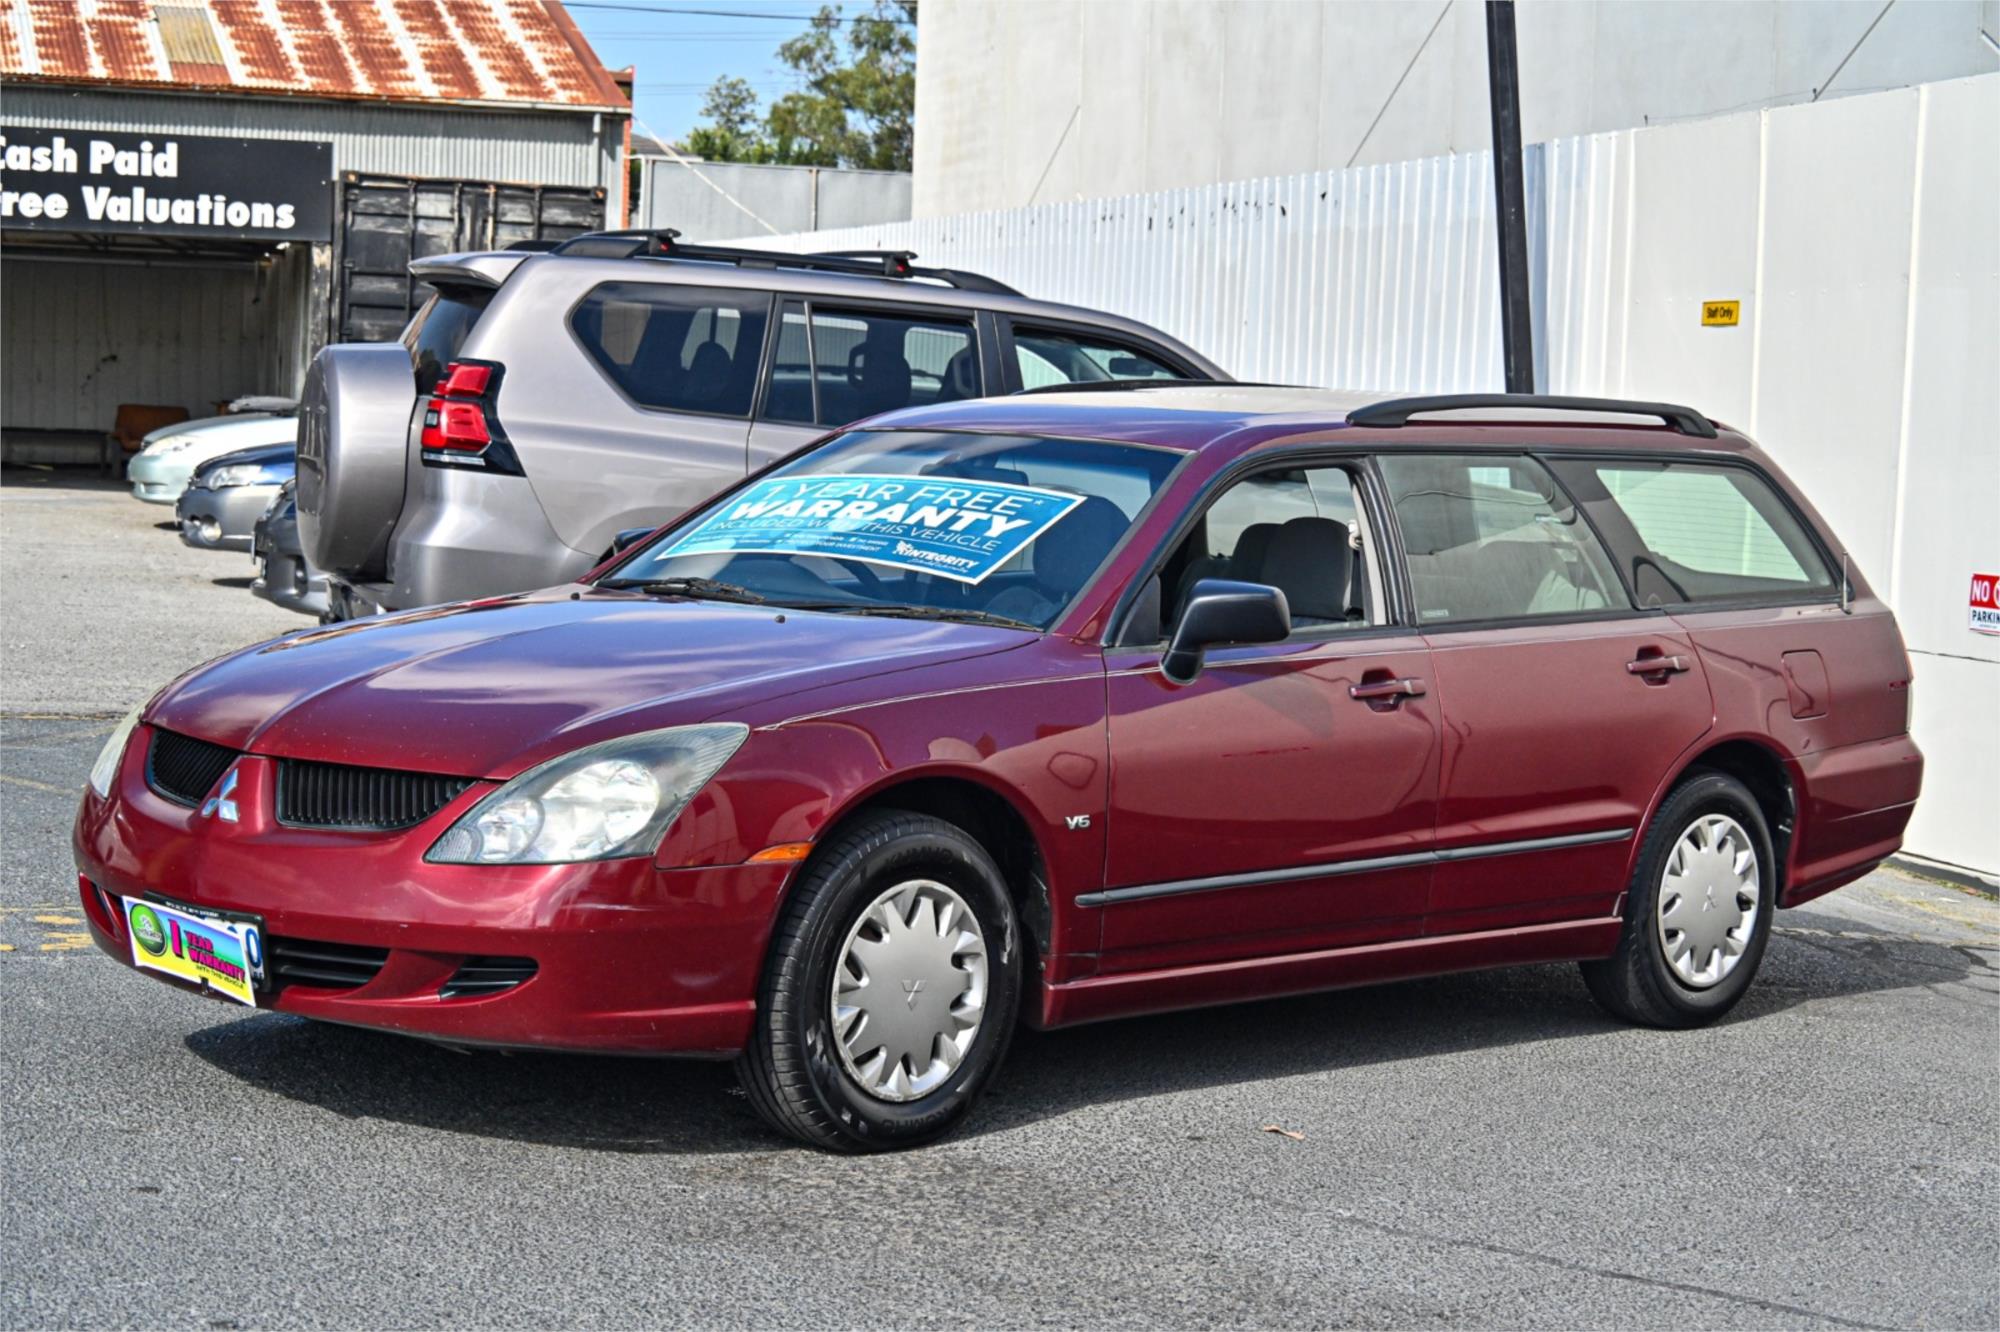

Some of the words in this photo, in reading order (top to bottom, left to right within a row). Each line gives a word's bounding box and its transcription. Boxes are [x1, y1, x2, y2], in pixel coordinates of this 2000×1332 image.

[0, 135, 78, 173] ash
[89, 139, 178, 178] Paid
[0, 181, 69, 219] ree
[81, 185, 296, 229] Valuations
[793, 482, 905, 501] YEAR
[729, 499, 1032, 538] WARRANTY
[861, 522, 908, 536] THIS
[911, 526, 1003, 551] VEHICLE
[1972, 579, 1991, 603] NO
[1065, 814, 1090, 830] V6
[184, 929, 215, 954] YEAR
